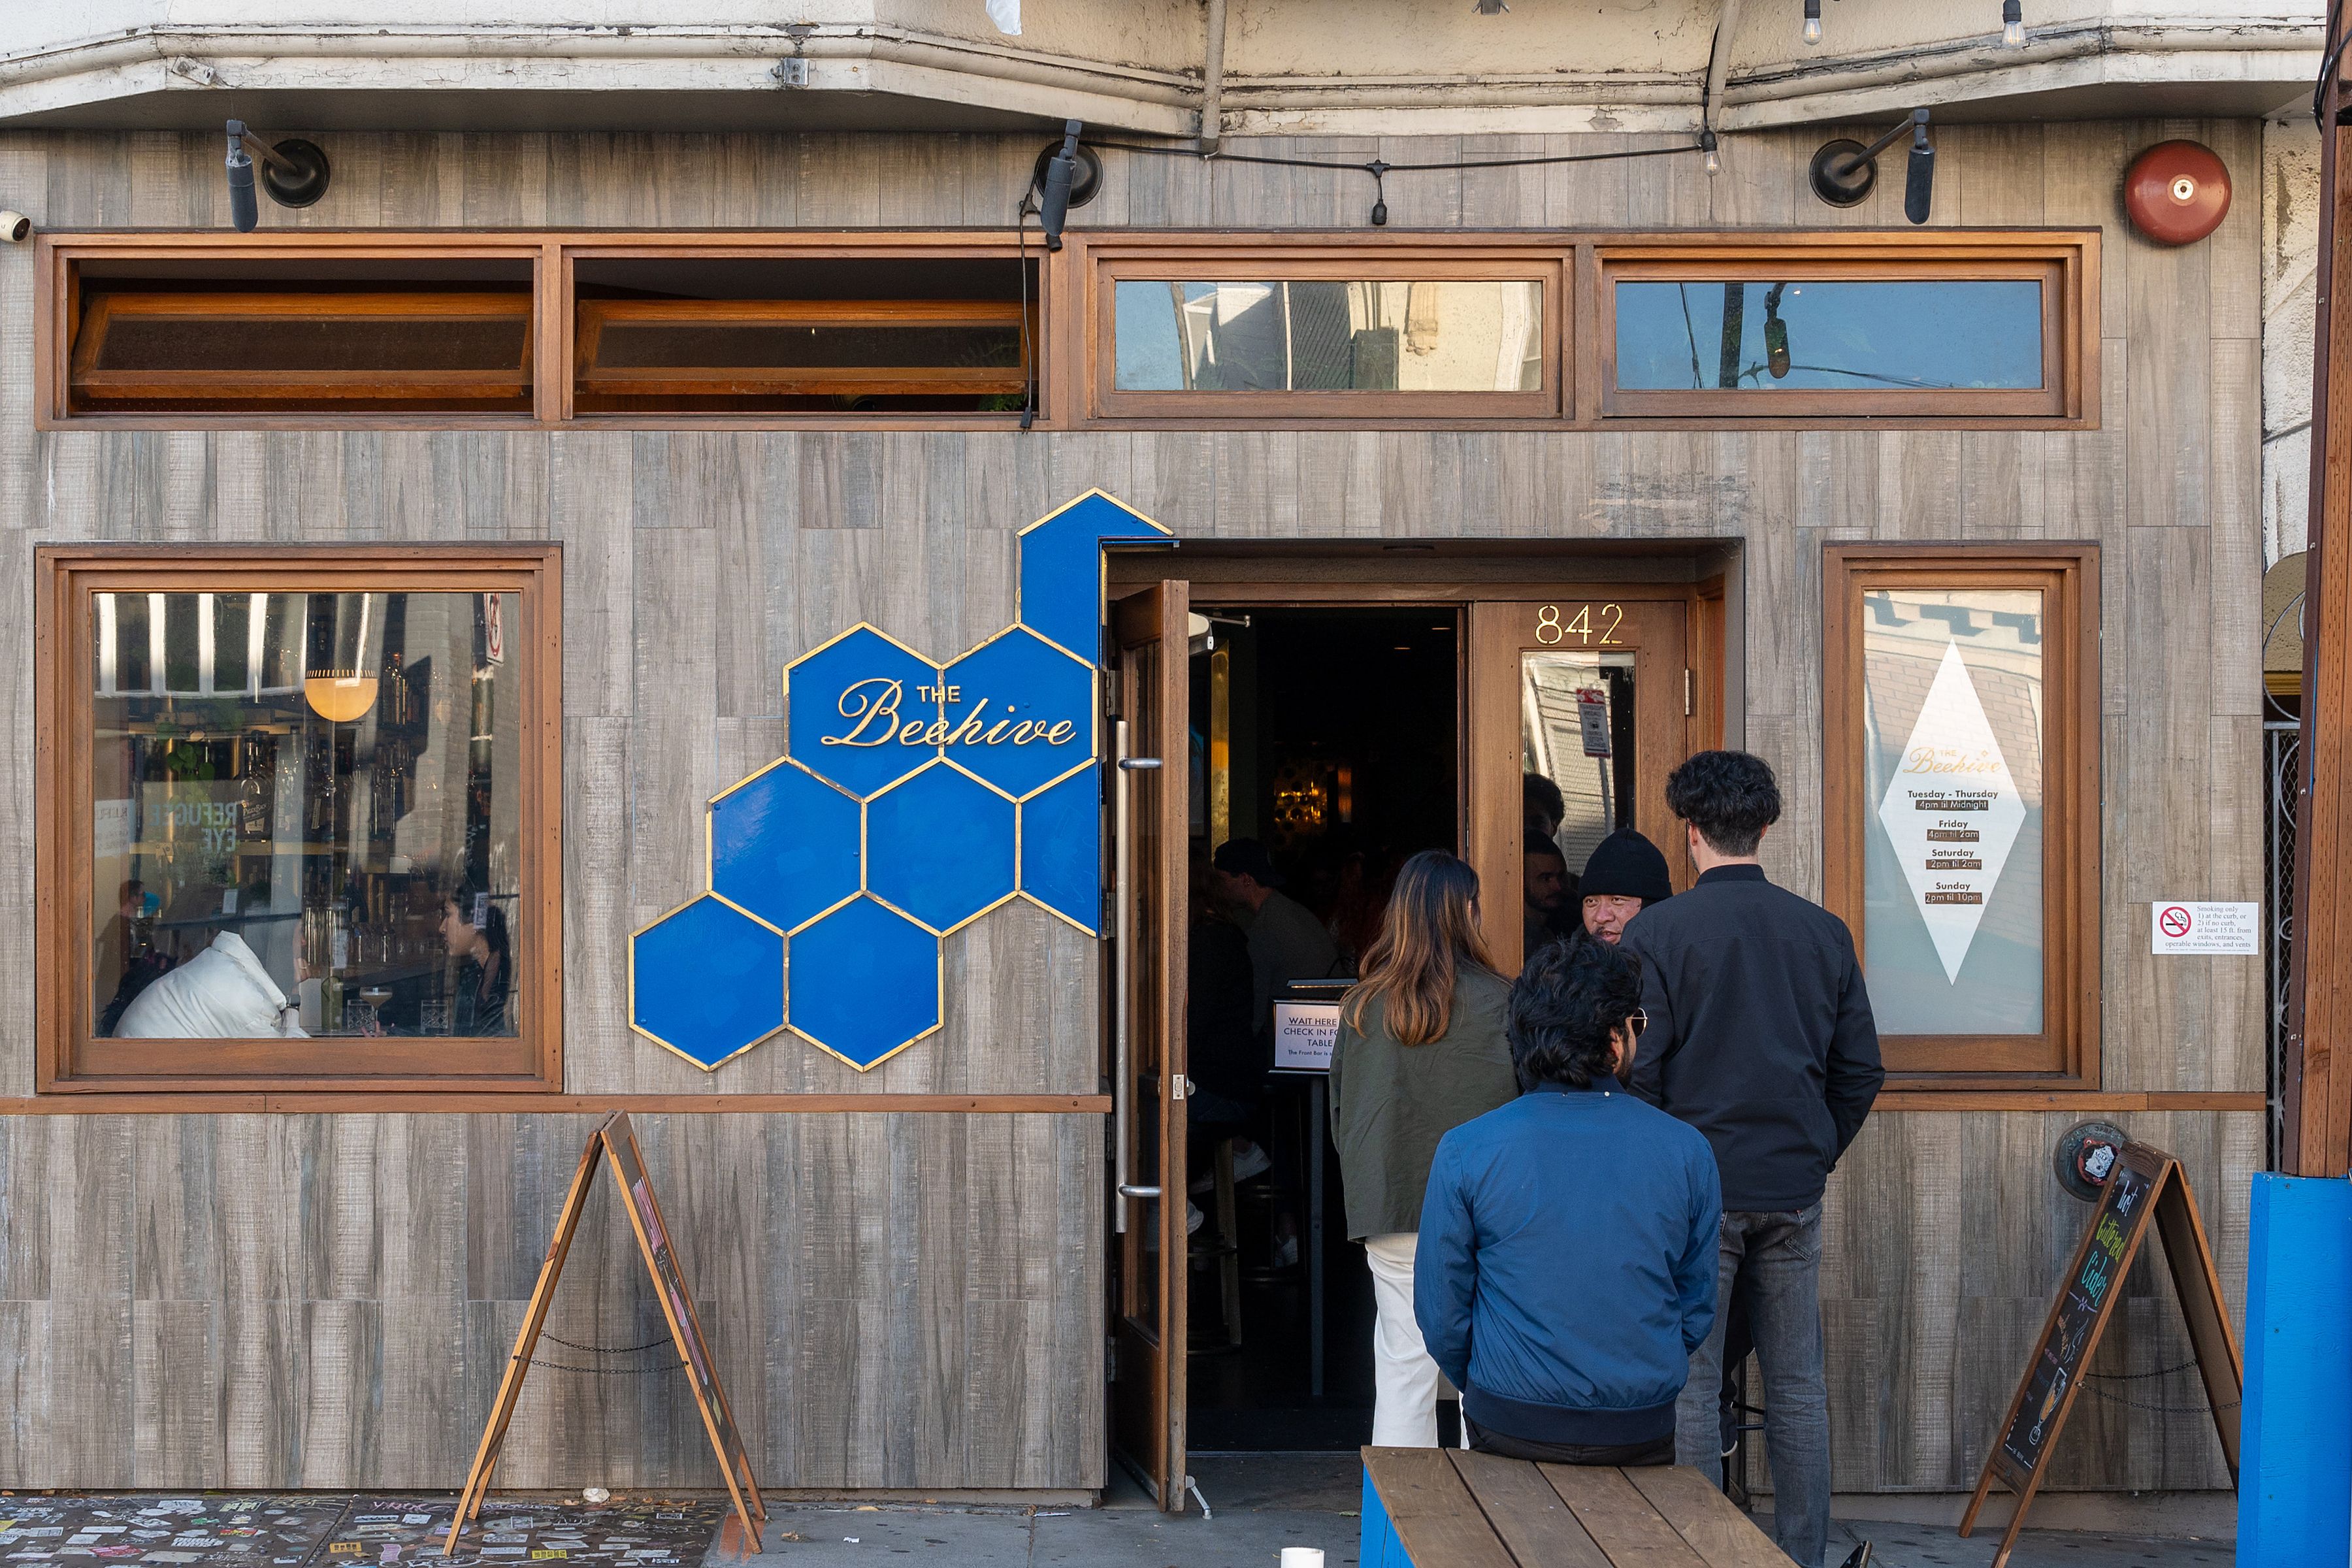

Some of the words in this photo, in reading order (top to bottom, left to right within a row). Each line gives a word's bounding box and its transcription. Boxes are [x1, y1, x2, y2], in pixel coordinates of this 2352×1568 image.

[1535, 604, 1623, 645] 842
[917, 685, 961, 704] THE
[821, 678, 1076, 747] Beehive
[1903, 747, 2001, 774] Beehive
[1908, 790, 1946, 799] Tuesday
[1955, 790, 1999, 799] Thursday
[1919, 800, 1938, 809] 4pm
[1950, 800, 1987, 809] Midnight
[1939, 820, 1968, 829] Friday
[1928, 830, 1948, 840] 4pm
[1932, 849, 1974, 858] Saturday
[1931, 860, 1950, 869] 2pm
[1936, 882, 1970, 891] Sunday
[1925, 894, 1944, 903] 2pm
[1957, 893, 1981, 902] 10pm
[2117, 1180, 2138, 1217] hot
[2081, 1250, 2107, 1307] Cider
